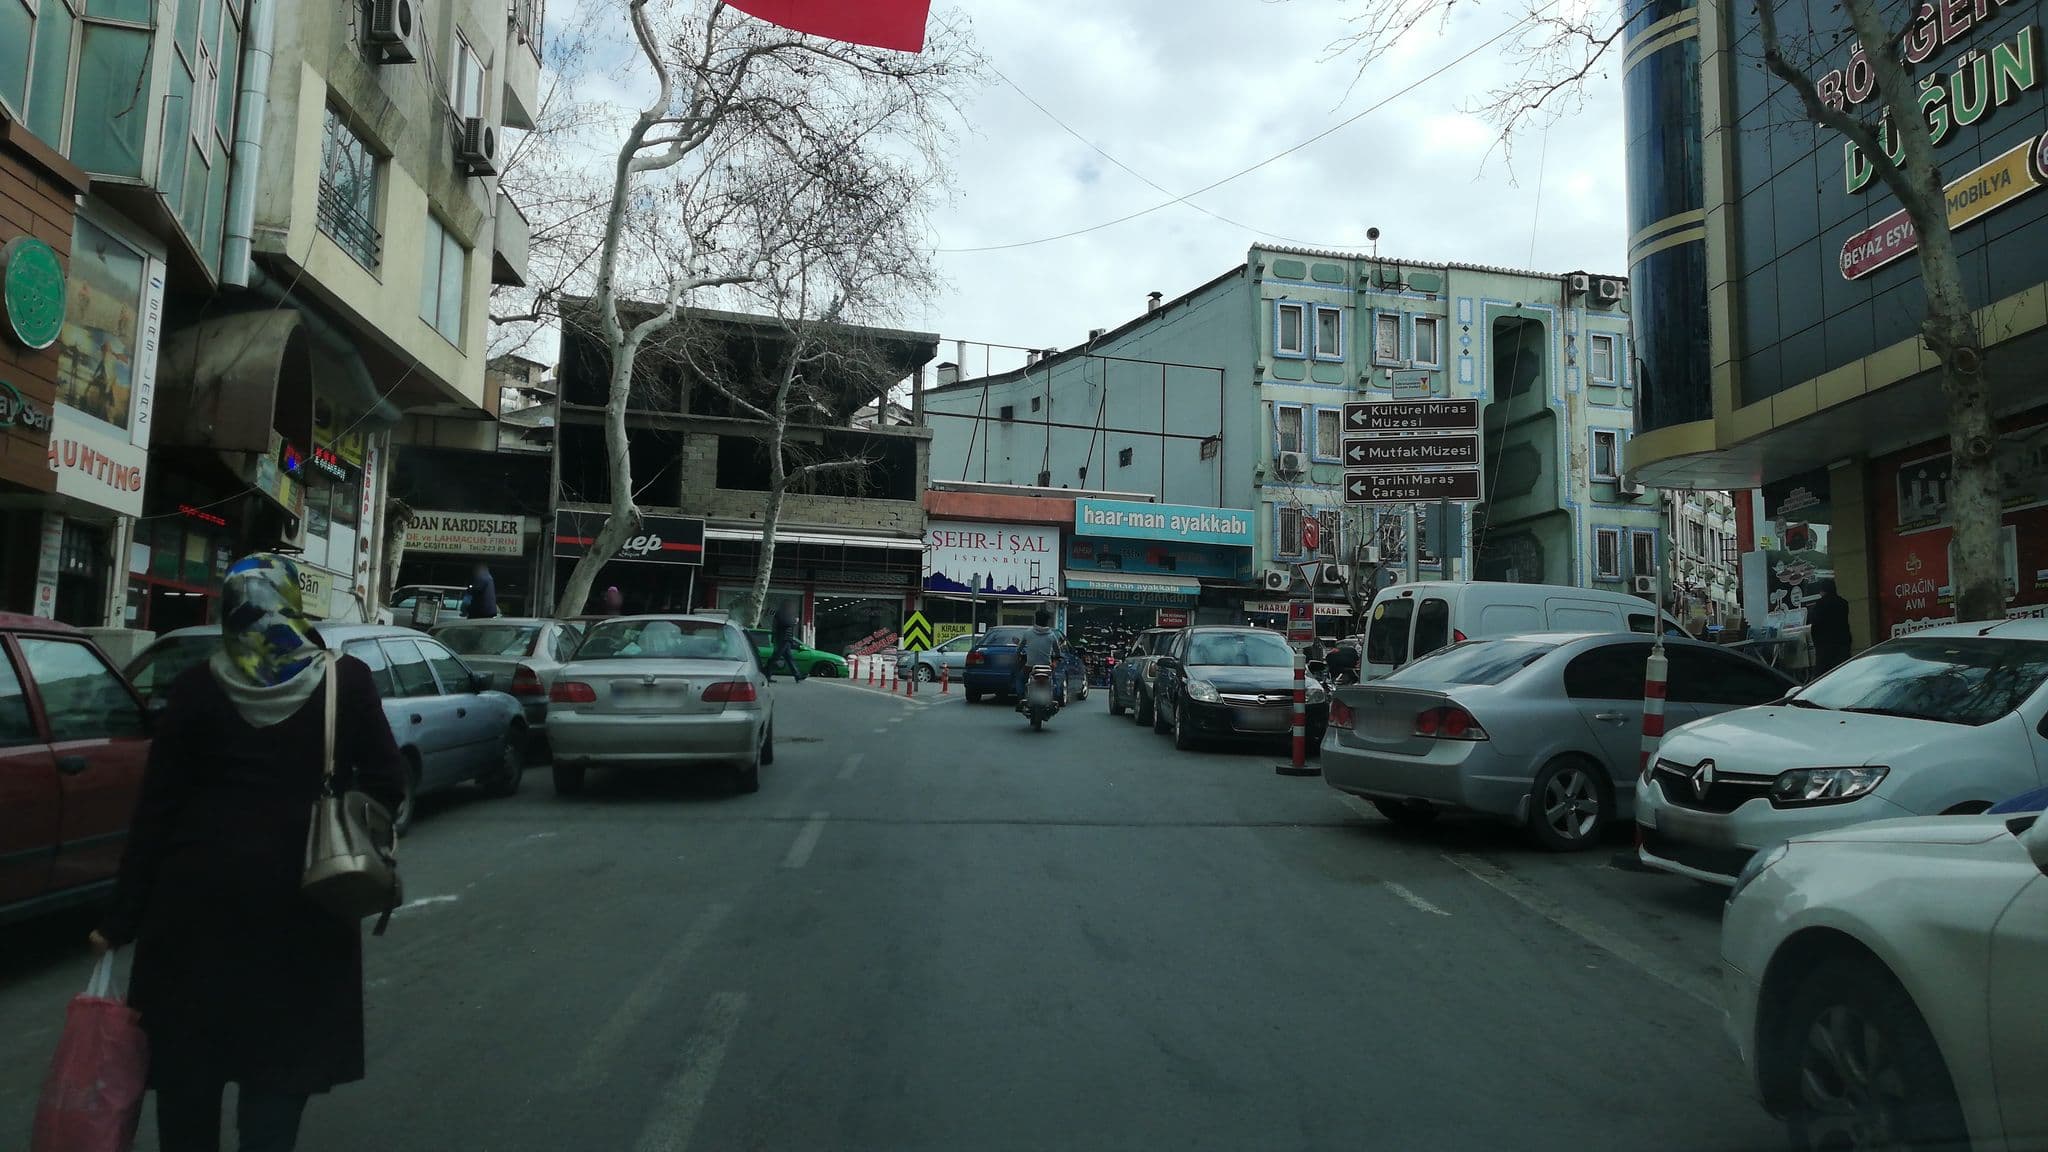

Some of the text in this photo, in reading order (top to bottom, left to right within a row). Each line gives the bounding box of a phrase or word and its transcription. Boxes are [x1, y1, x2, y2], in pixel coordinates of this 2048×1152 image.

[1946, 168, 2011, 215] MOBİLYA
[1844, 235, 1883, 269] BEYAZ
[1371, 404, 1467, 416] Kültürel Miras
[1371, 418, 1422, 428] Müzesi
[1369, 445, 1471, 458] Mutfak Müzesi
[1371, 475, 1455, 486] Tarihi Maraş
[1372, 488, 1420, 499] Çarşısı
[1083, 505, 1246, 535] haar-man ayakkabı
[442, 518, 517, 536] KARDEŞLER
[932, 530, 1050, 555] ŞEHR-İ ŞAL
[1905, 601, 1927, 611] AVM
